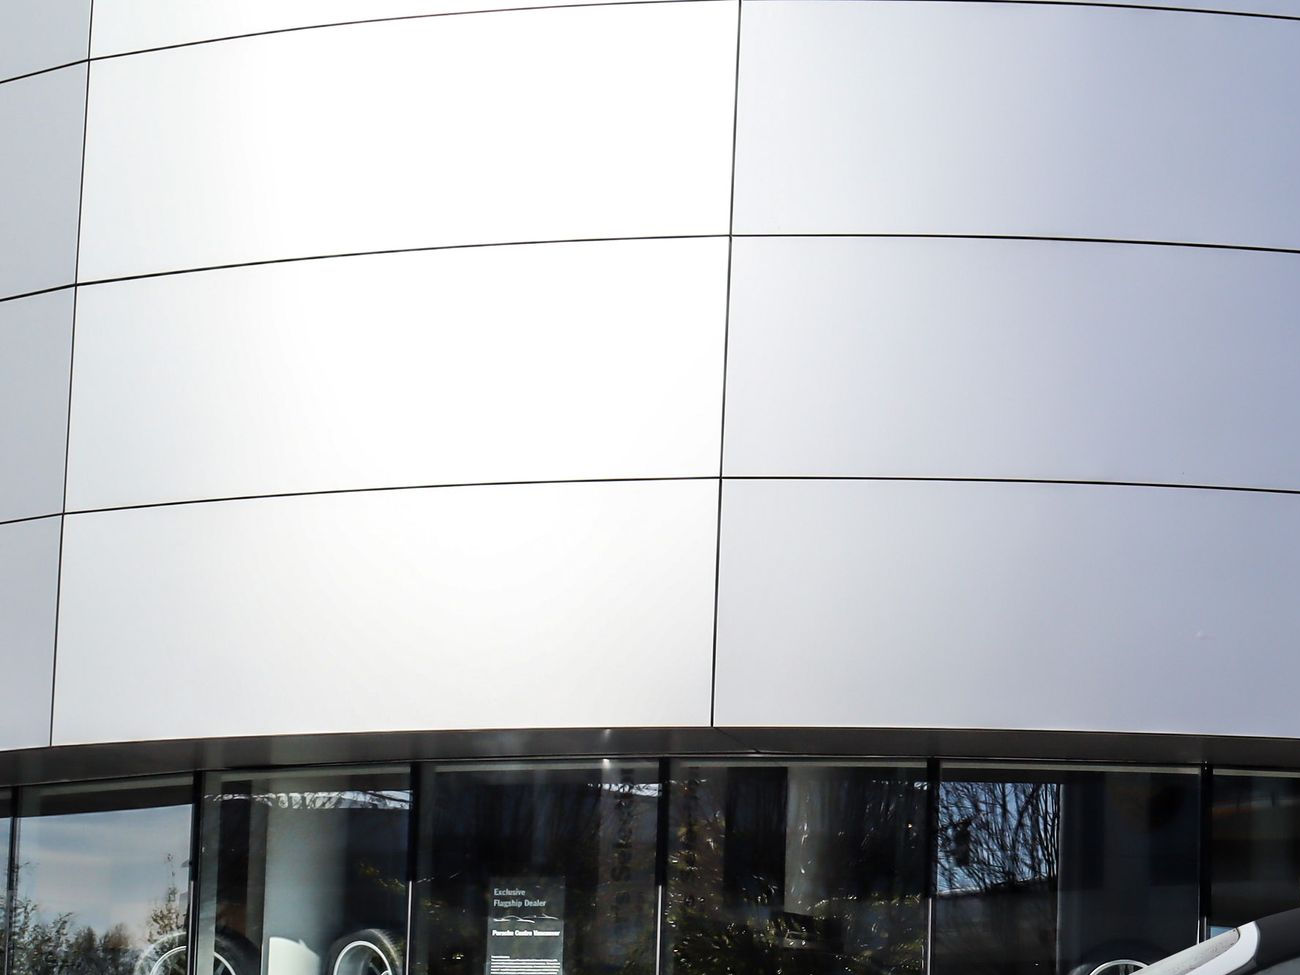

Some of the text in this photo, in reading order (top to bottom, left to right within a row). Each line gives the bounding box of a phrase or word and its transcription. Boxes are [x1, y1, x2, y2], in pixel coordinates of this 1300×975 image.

[493, 888, 526, 896] Exclusive
[493, 899, 547, 908] Flagship Dealer
